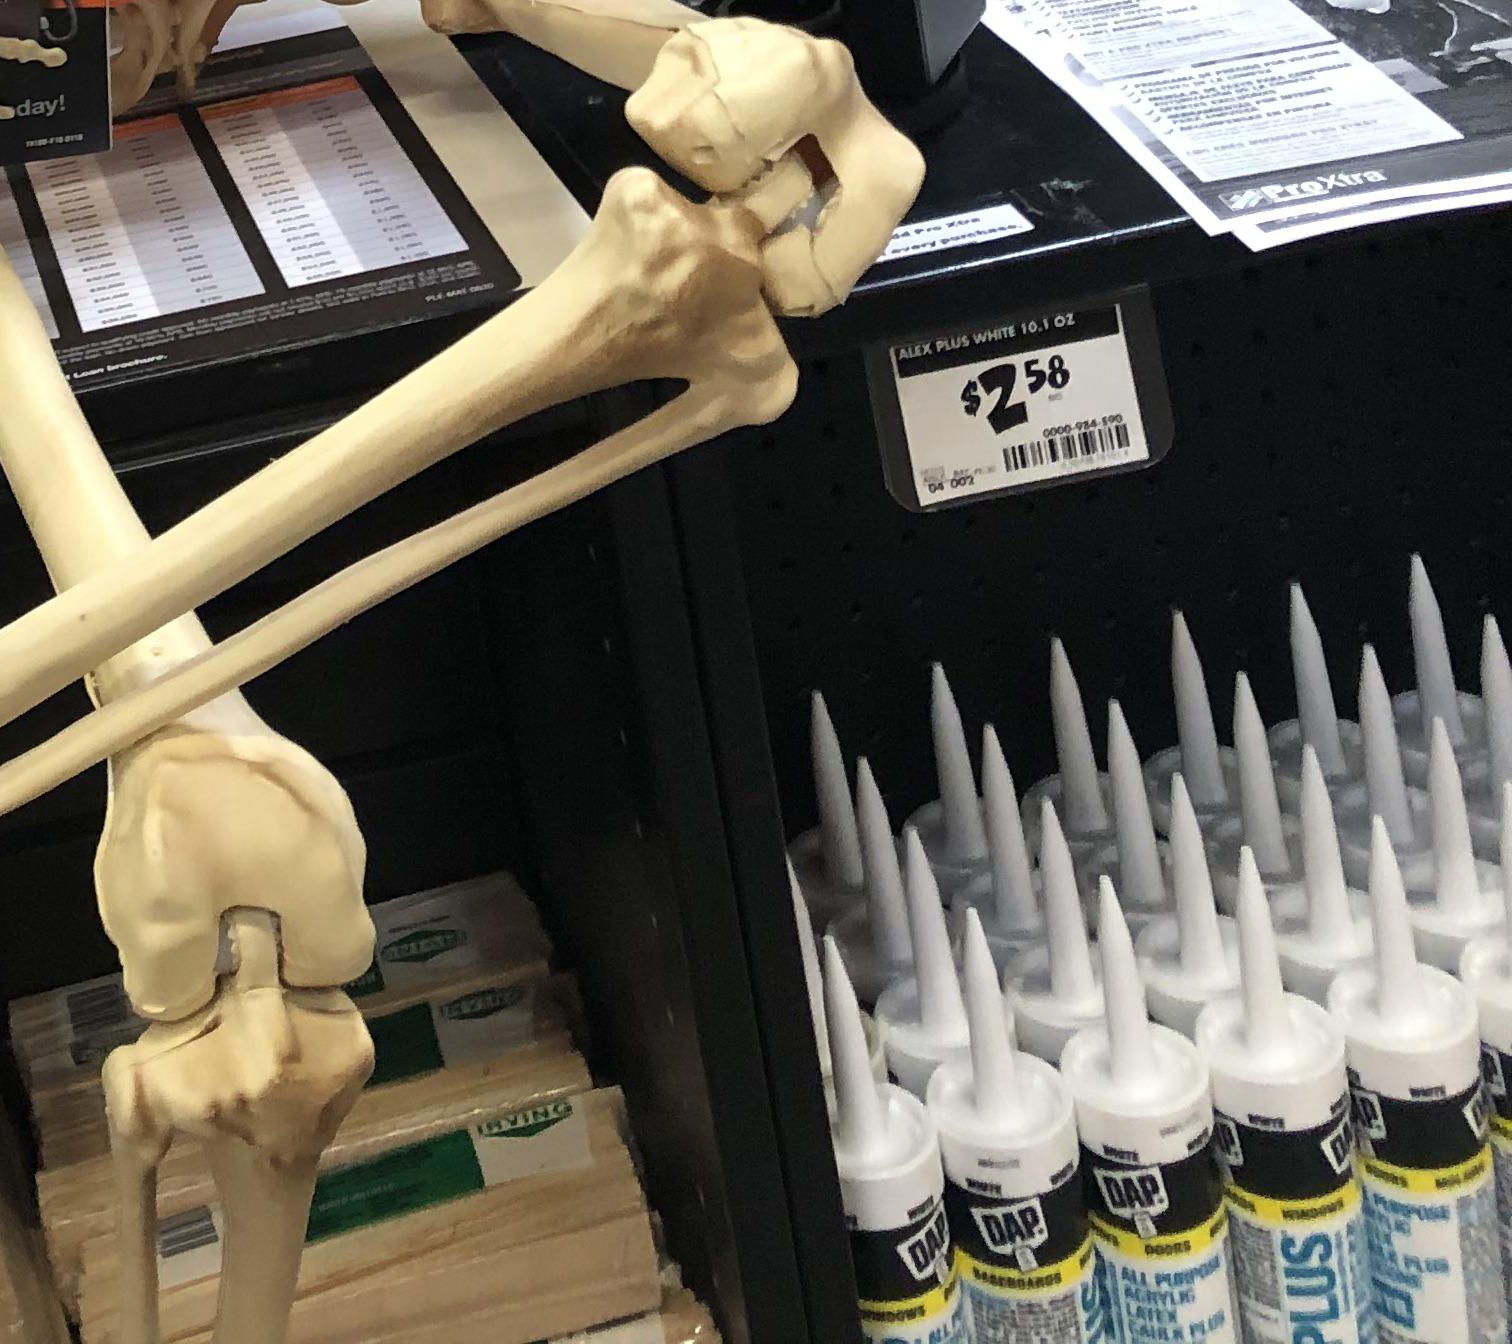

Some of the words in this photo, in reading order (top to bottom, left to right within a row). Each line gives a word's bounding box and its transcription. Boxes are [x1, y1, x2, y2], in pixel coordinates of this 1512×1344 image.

[898, 340, 933, 361] ALEX
[935, 334, 971, 354] PLUS
[972, 326, 1017, 346] WHITE
[1020, 318, 1049, 336] 10.1
[1053, 312, 1076, 328] OZ
